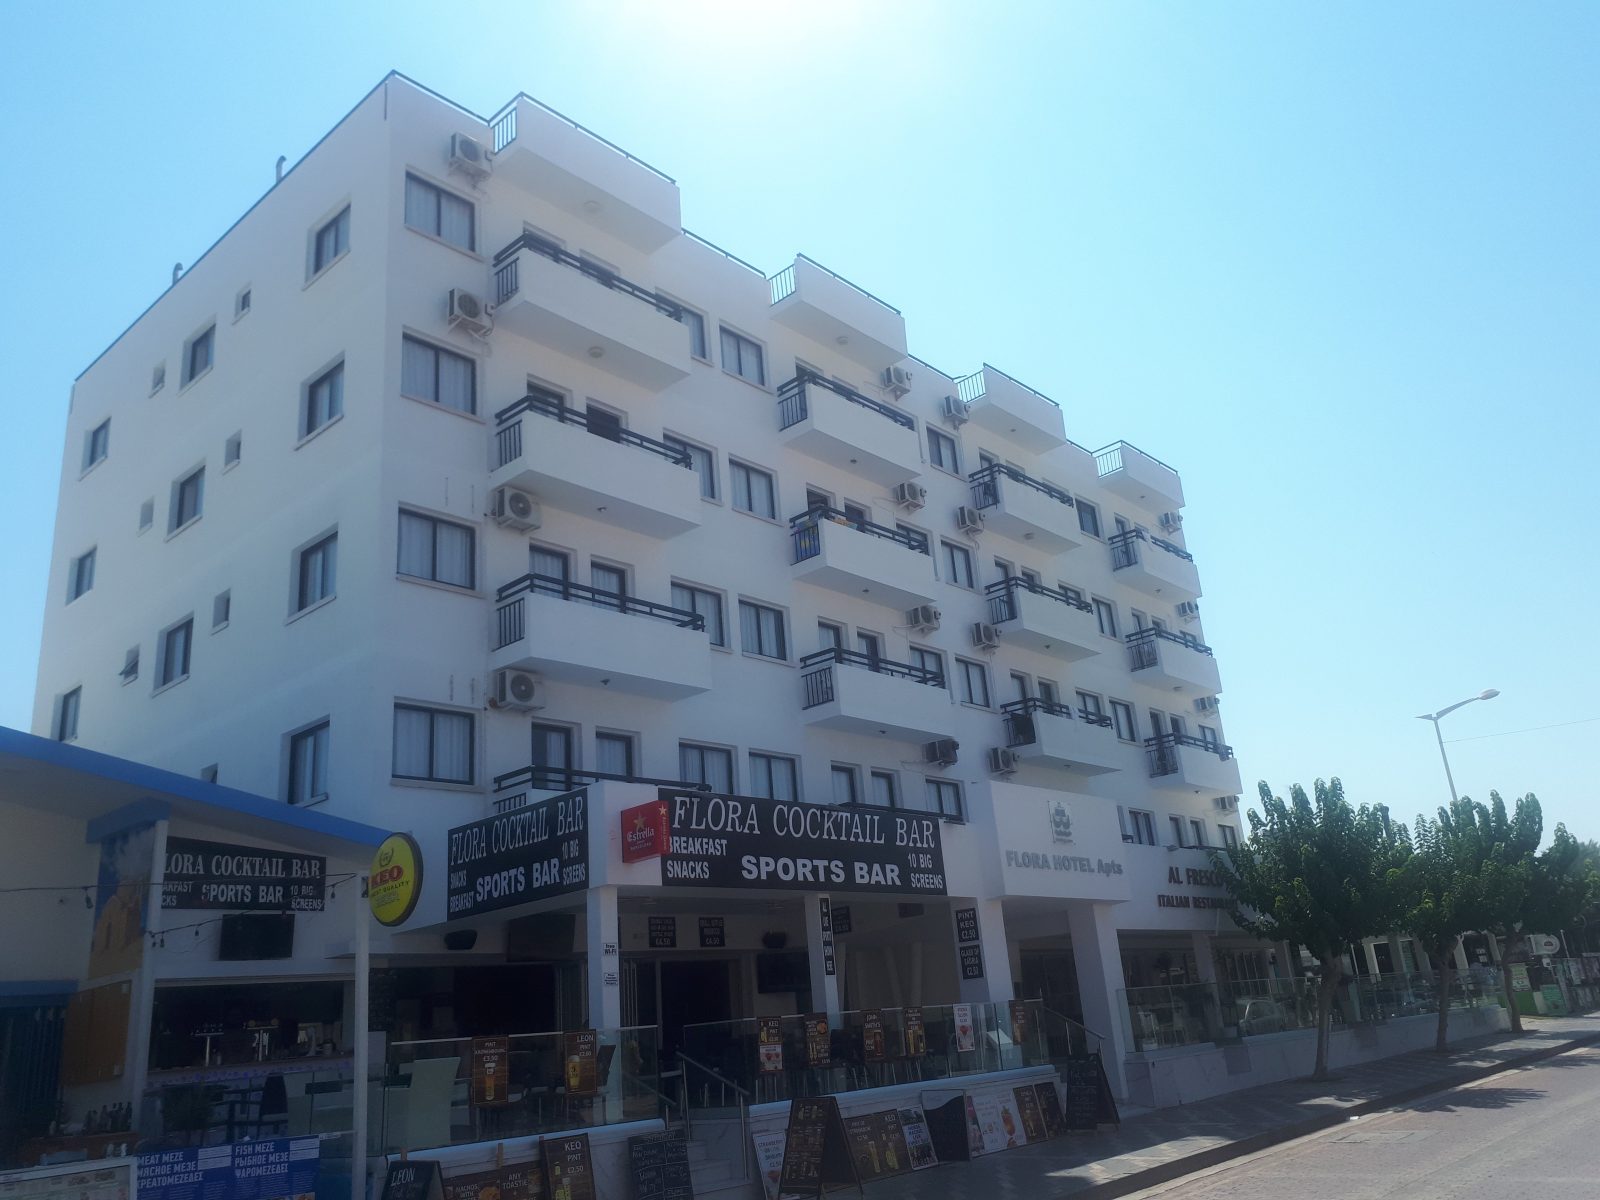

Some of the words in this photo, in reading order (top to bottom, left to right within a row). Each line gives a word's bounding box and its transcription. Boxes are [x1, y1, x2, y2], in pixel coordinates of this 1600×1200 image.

[673, 797, 760, 834] FLORA
[773, 804, 885, 844] COCKTAIL
[896, 818, 935, 848] BAR
[451, 826, 486, 865] FLORA
[492, 807, 549, 854] COCKTAIL
[557, 797, 584, 836] BAR
[627, 826, 655, 842] Estrella
[562, 841, 568, 860] 10
[570, 839, 579, 858] BIG
[669, 836, 728, 856] BREAKFAST
[211, 855, 286, 878] COCKTAIL
[291, 859, 320, 879] BAR
[908, 853, 916, 868] 10
[919, 855, 932, 869] BIG
[1006, 851, 1051, 870] FLORA
[1053, 855, 1095, 872] HOTEL
[1097, 859, 1123, 877] Apts
[563, 863, 585, 885] SCREENS
[667, 860, 709, 879] SNACKS
[741, 855, 845, 882] SPORTS
[853, 862, 902, 886] BAR
[1168, 866, 1183, 885] AL
[383, 880, 410, 892] QUALITY
[450, 870, 467, 889] SNACKS
[476, 866, 525, 902] SPORTS
[532, 858, 560, 888] BAR
[911, 873, 943, 889] SCREENS
[202, 884, 252, 903] SPORTS
[258, 885, 283, 903] BAR
[1158, 895, 1190, 907] ITALIAN
[291, 899, 322, 910] SCREENS
[960, 920, 975, 929] KEO
[577, 1034, 594, 1043] LEON
[235, 1144, 253, 1156] FISH
[254, 1142, 275, 1153] MEZE
[564, 1141, 582, 1152] KEO
[137, 1154, 160, 1166] MEAT
[162, 1151, 184, 1163] MEZE
[235, 1153, 266, 1167] РЫБНОЕ
[267, 1151, 289, 1163] МЕЗЕ
[566, 1154, 581, 1162] PINT
[173, 1161, 196, 1172] МЕЗЕ
[391, 1167, 415, 1187] LEON
[503, 1179, 529, 1190] TOASTIE
[509, 1172, 522, 1182] ANY
[455, 1183, 479, 1193] NACHOS
